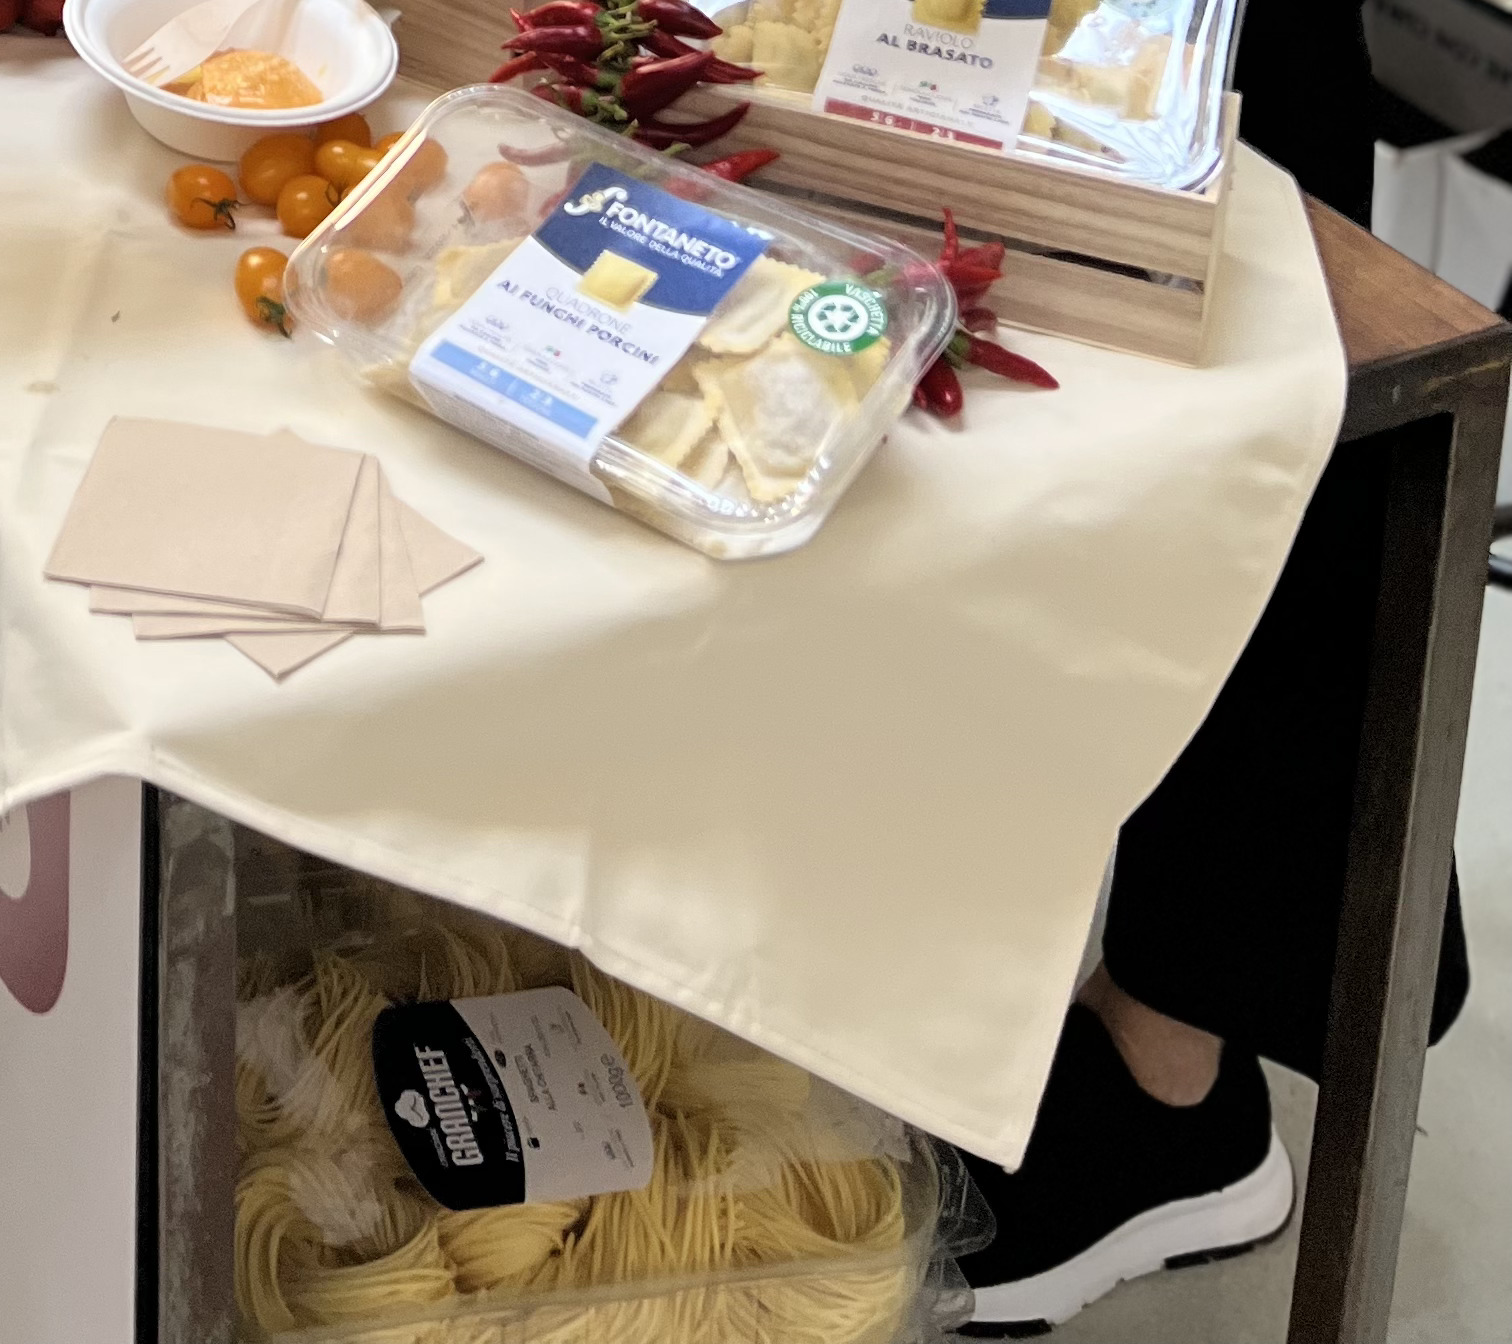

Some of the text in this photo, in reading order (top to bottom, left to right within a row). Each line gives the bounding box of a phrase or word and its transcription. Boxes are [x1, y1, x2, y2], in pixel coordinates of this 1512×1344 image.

[875, 32, 994, 70] AL BRASATO
[903, 23, 974, 50] RAVIOLO
[606, 201, 737, 270] FONTANETO
[610, 221, 650, 245] VALORE
[649, 239, 680, 260] DELLA
[496, 279, 519, 295] AI
[518, 289, 587, 330] FUNGHI
[586, 323, 660, 365] PORCINI
[545, 286, 633, 336] QUADRONE
[413, 1043, 485, 1167] GRANCHEF
